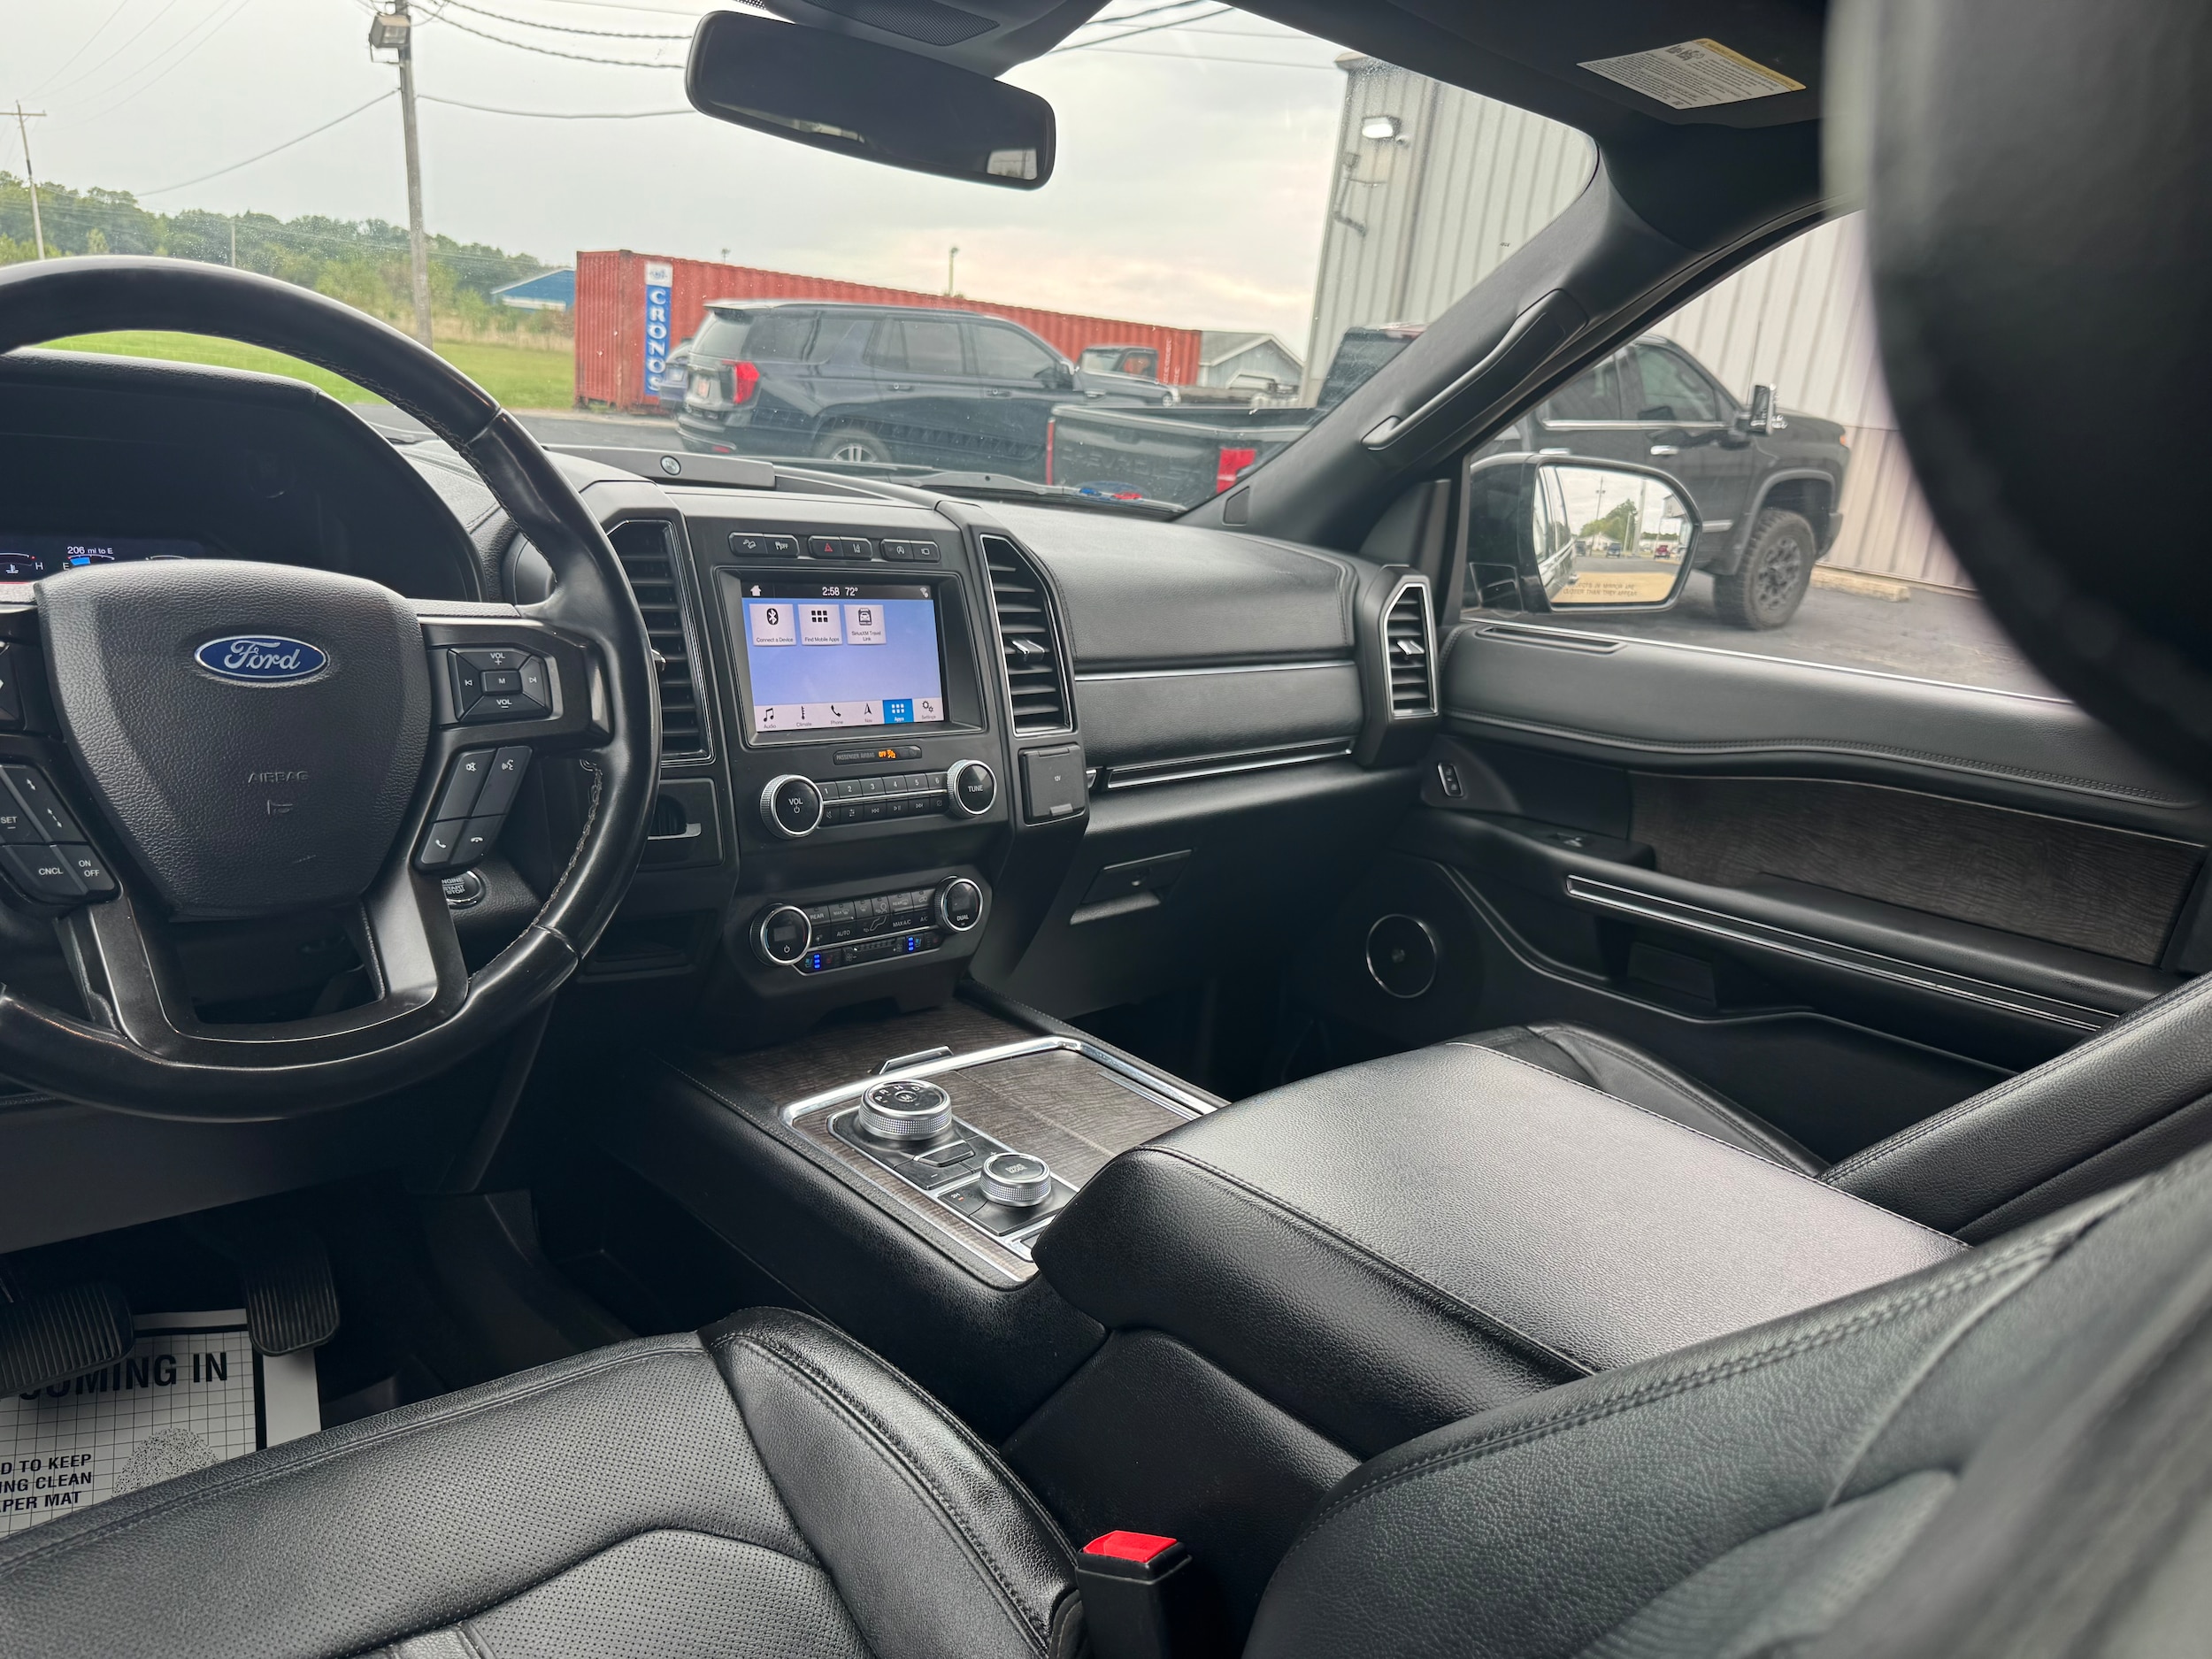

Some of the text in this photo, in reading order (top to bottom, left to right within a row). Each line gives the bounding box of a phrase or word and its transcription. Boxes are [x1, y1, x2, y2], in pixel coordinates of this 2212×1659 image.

[647, 288, 667, 392] CRONOS
[66, 546, 85, 555] 206
[822, 587, 858, 596] 2:58 72°
[224, 640, 301, 670] Ford
[248, 771, 308, 783] AIRBAG
[967, 784, 984, 793] TUNE
[38, 867, 64, 876] CNCL
[193, 1352, 227, 1383] IN
[19, 1459, 42, 1473] TO
[48, 1454, 92, 1471] KEEP
[35, 1471, 92, 1490] CLEAN
[0, 1491, 81, 1513] PER MAT
